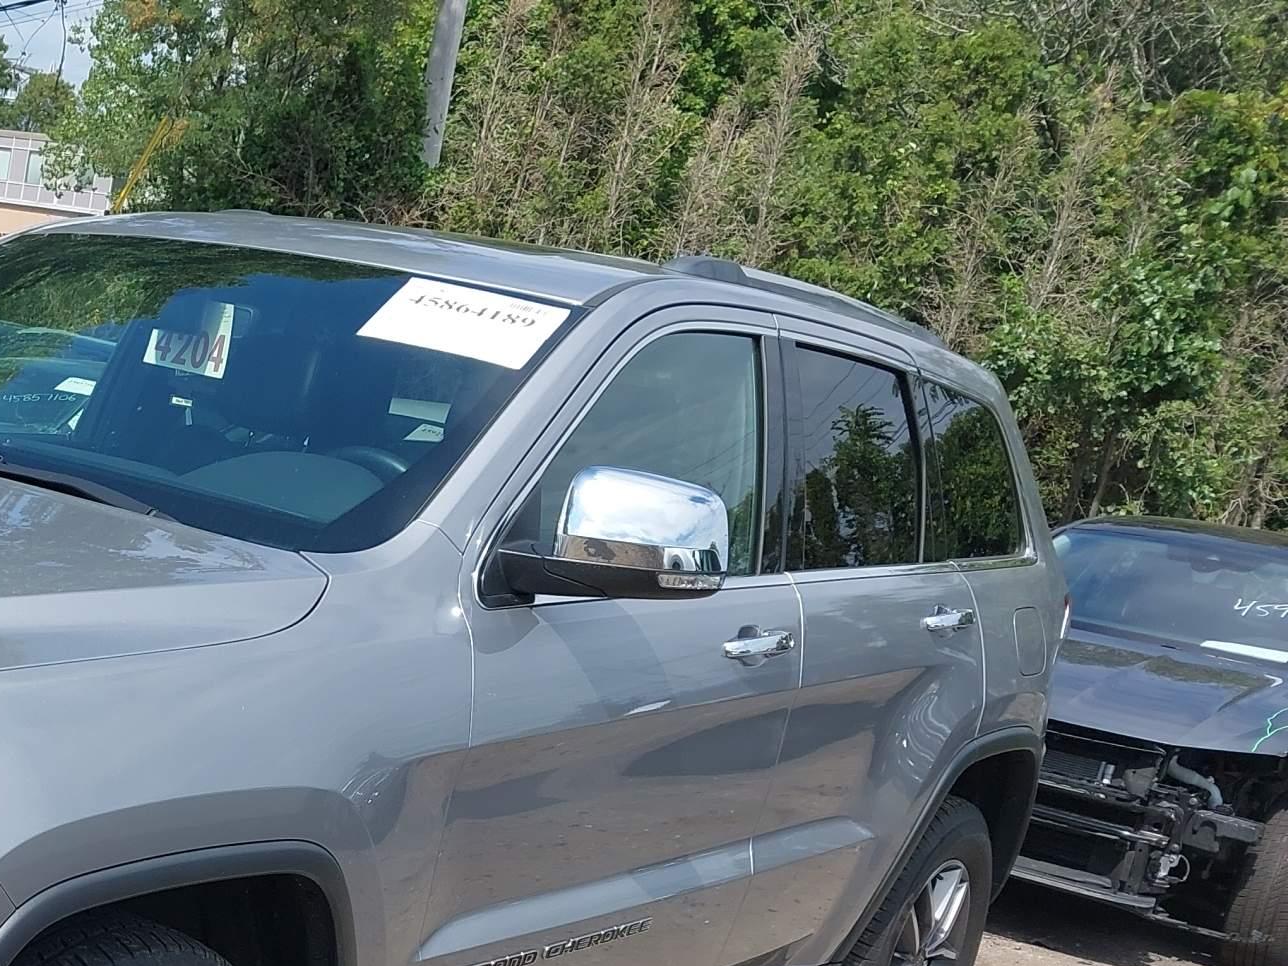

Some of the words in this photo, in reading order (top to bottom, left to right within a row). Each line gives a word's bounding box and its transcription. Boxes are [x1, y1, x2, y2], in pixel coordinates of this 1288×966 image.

[408, 294, 537, 328] 45864189
[154, 330, 227, 374] 4204
[541, 917, 653, 960] CHEROKEE
